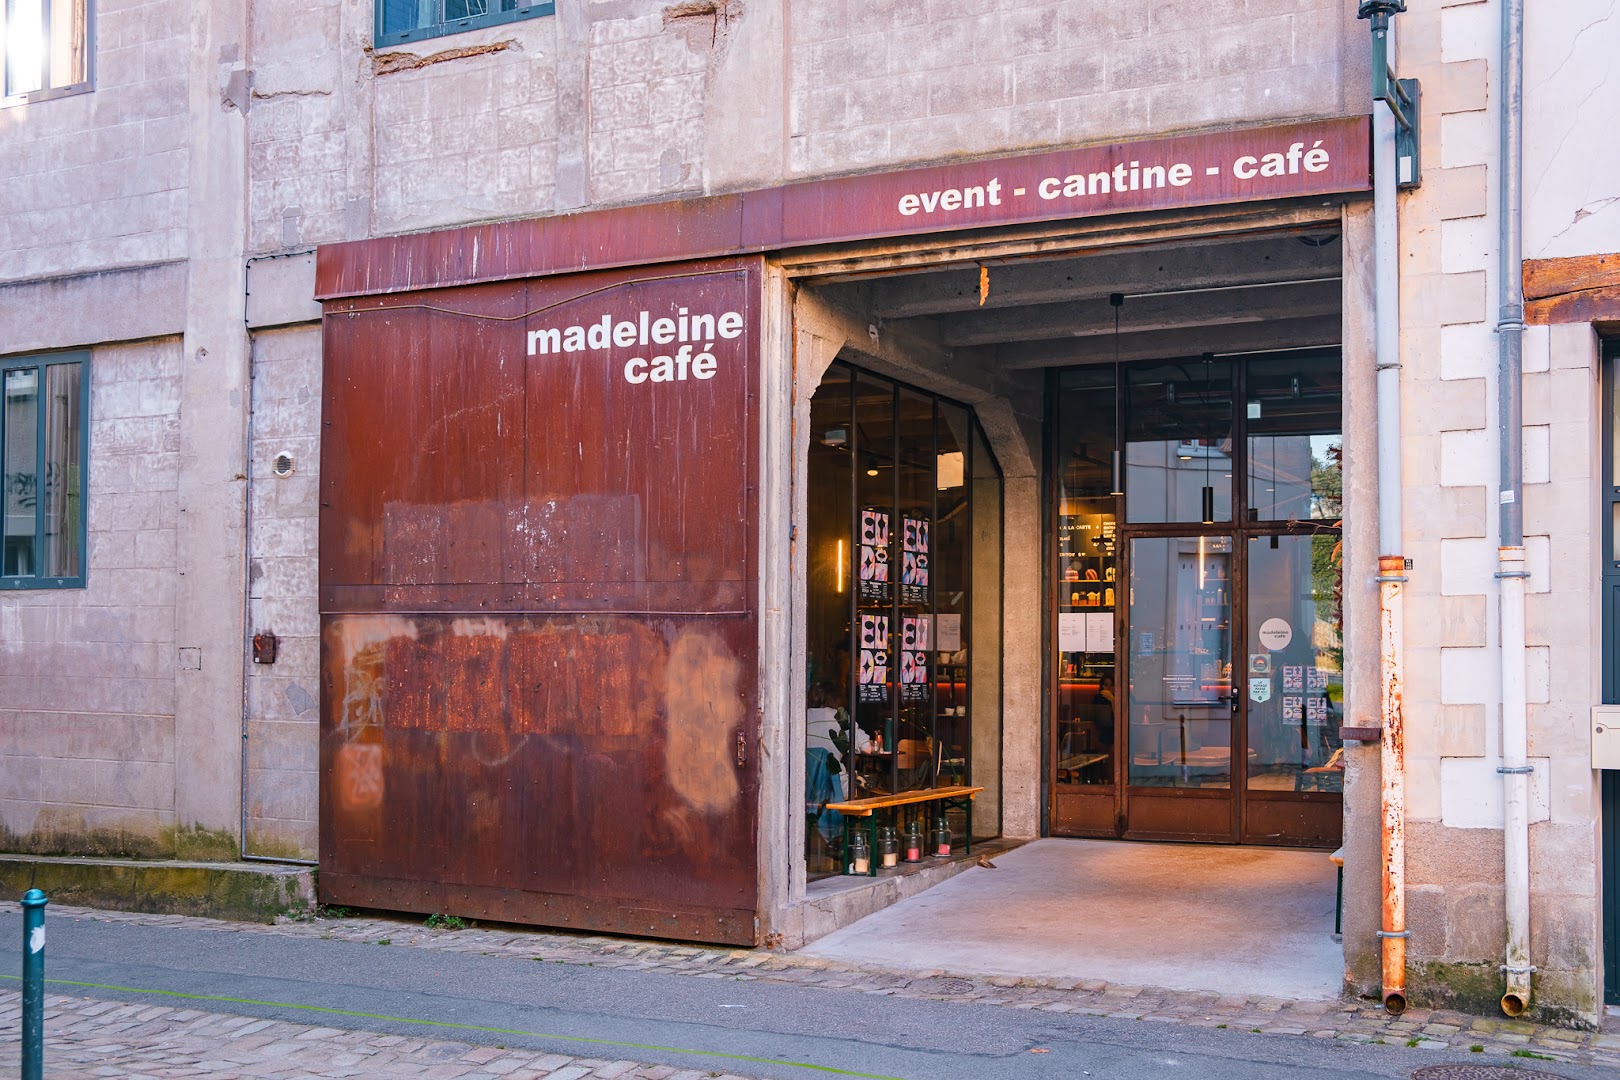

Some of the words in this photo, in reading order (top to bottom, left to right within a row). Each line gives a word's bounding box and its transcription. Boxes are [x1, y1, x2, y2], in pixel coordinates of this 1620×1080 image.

[898, 177, 1002, 216] event
[1038, 160, 1193, 200] cantine
[1233, 140, 1330, 180] café
[527, 307, 744, 356] madeleine
[624, 343, 718, 385] café
